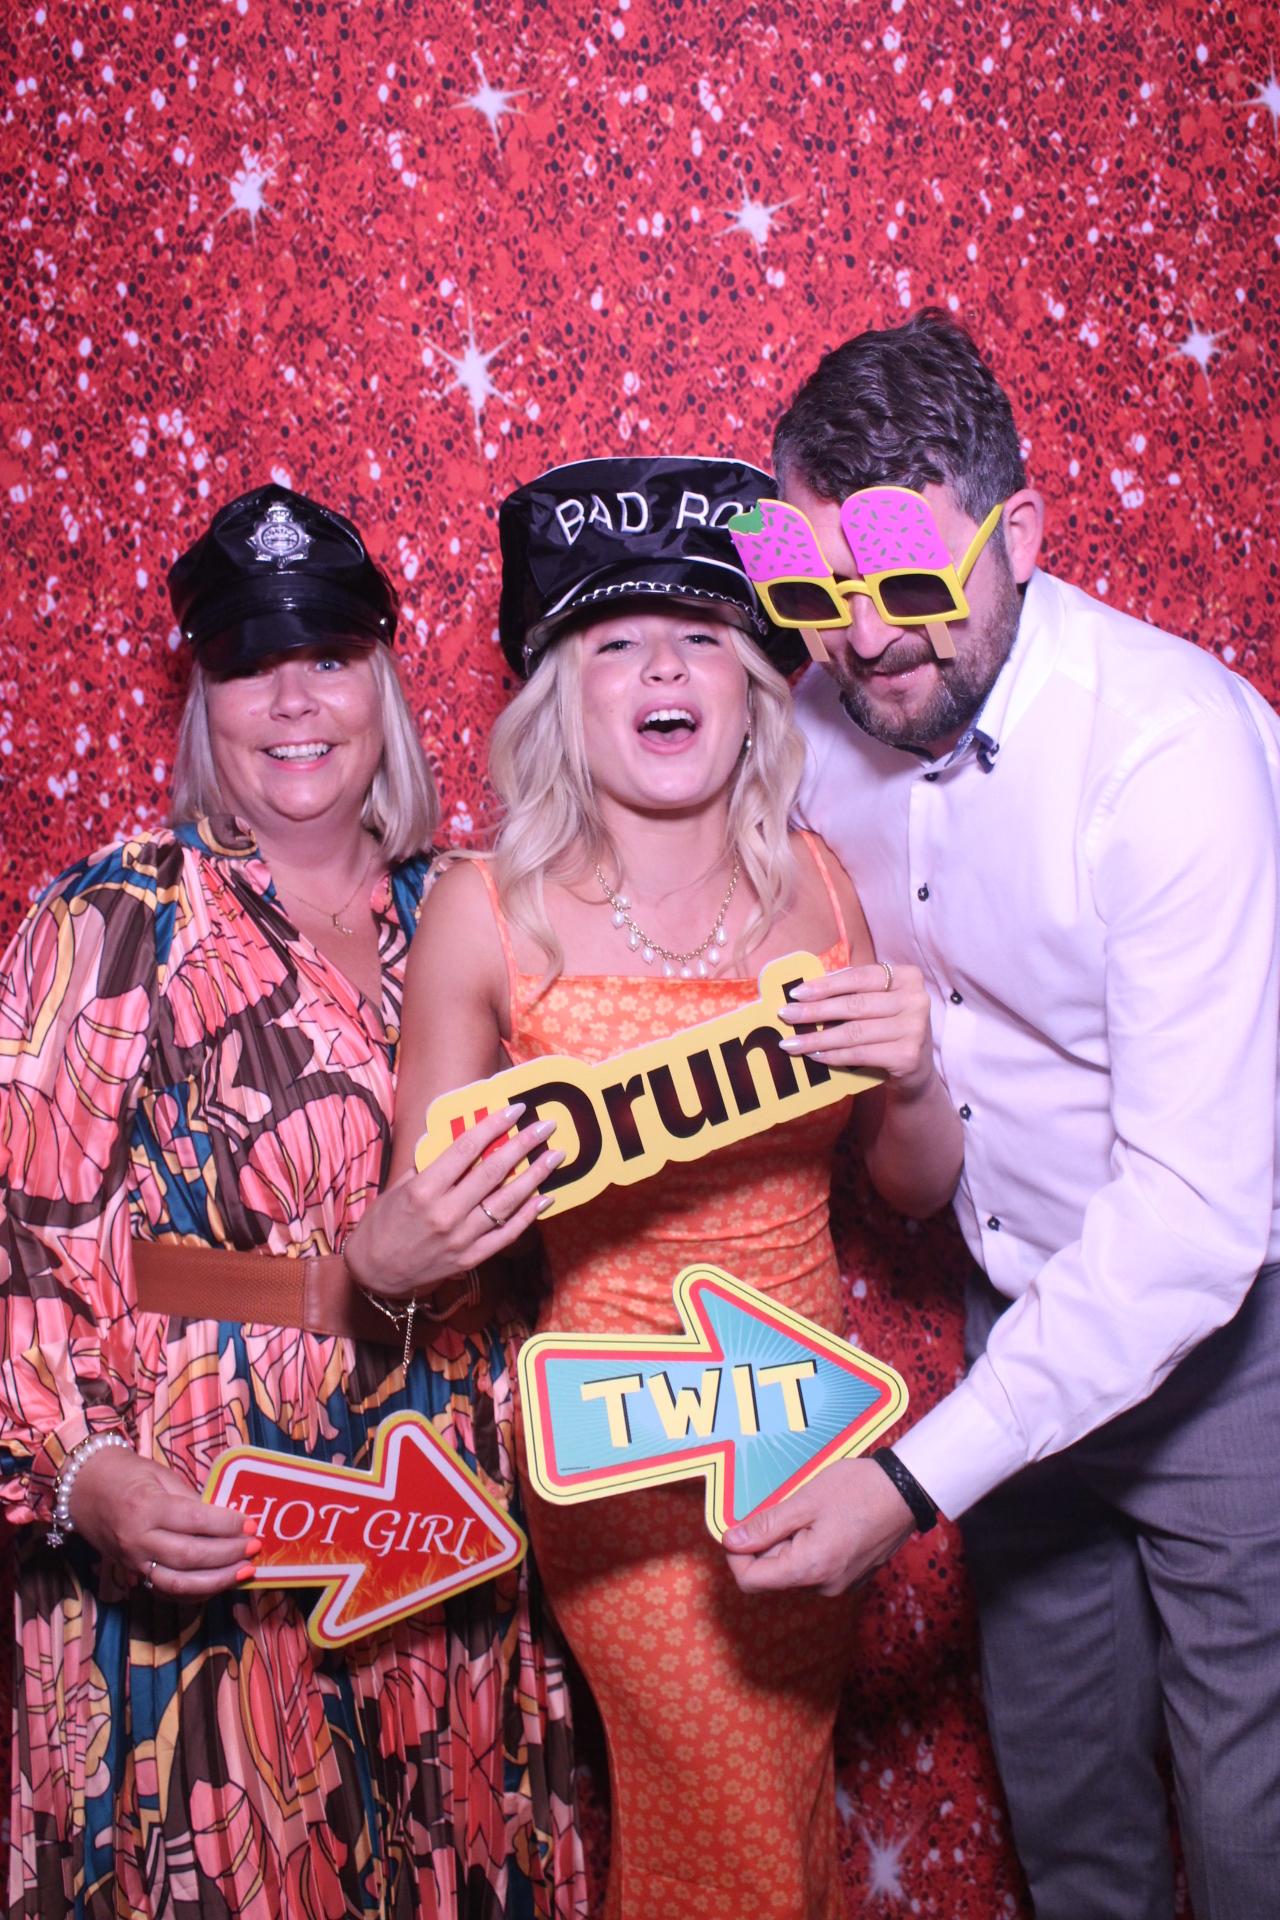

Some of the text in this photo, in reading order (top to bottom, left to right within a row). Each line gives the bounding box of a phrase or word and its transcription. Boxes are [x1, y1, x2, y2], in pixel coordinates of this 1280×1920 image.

[555, 491, 755, 545] BAD RO
[449, 976, 852, 1196] Drun
[580, 1359, 817, 1448] TWIT
[229, 1494, 477, 1566] HOT GIRL
